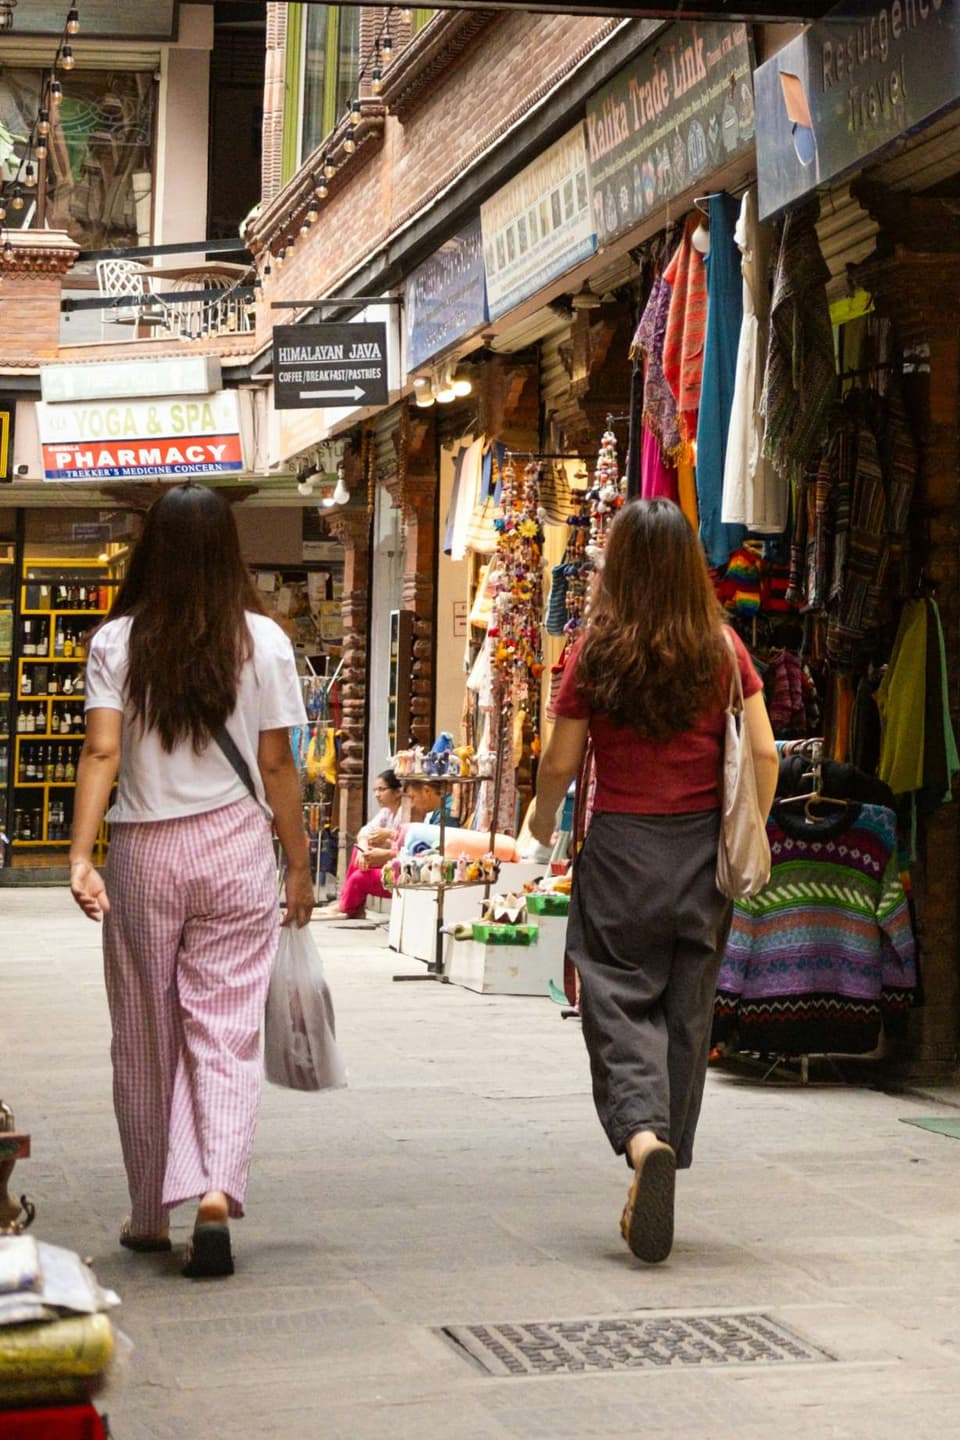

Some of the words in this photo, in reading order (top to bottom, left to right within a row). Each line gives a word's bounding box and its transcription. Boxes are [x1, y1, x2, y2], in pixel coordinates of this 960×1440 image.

[628, 57, 670, 131] Trade
[670, 24, 707, 100] Link
[848, 54, 906, 132] Travel
[279, 344, 343, 361] HIMALAYAN
[349, 343, 382, 359] JAVA
[74, 407, 137, 438] YOGA
[147, 406, 163, 435] &
[170, 403, 217, 433] SPA
[56, 444, 226, 469] PHARMACY
[67, 467, 120, 479] TREKKER'S
[123, 465, 171, 476] MEDICINE
[174, 463, 223, 474] CONCERN
